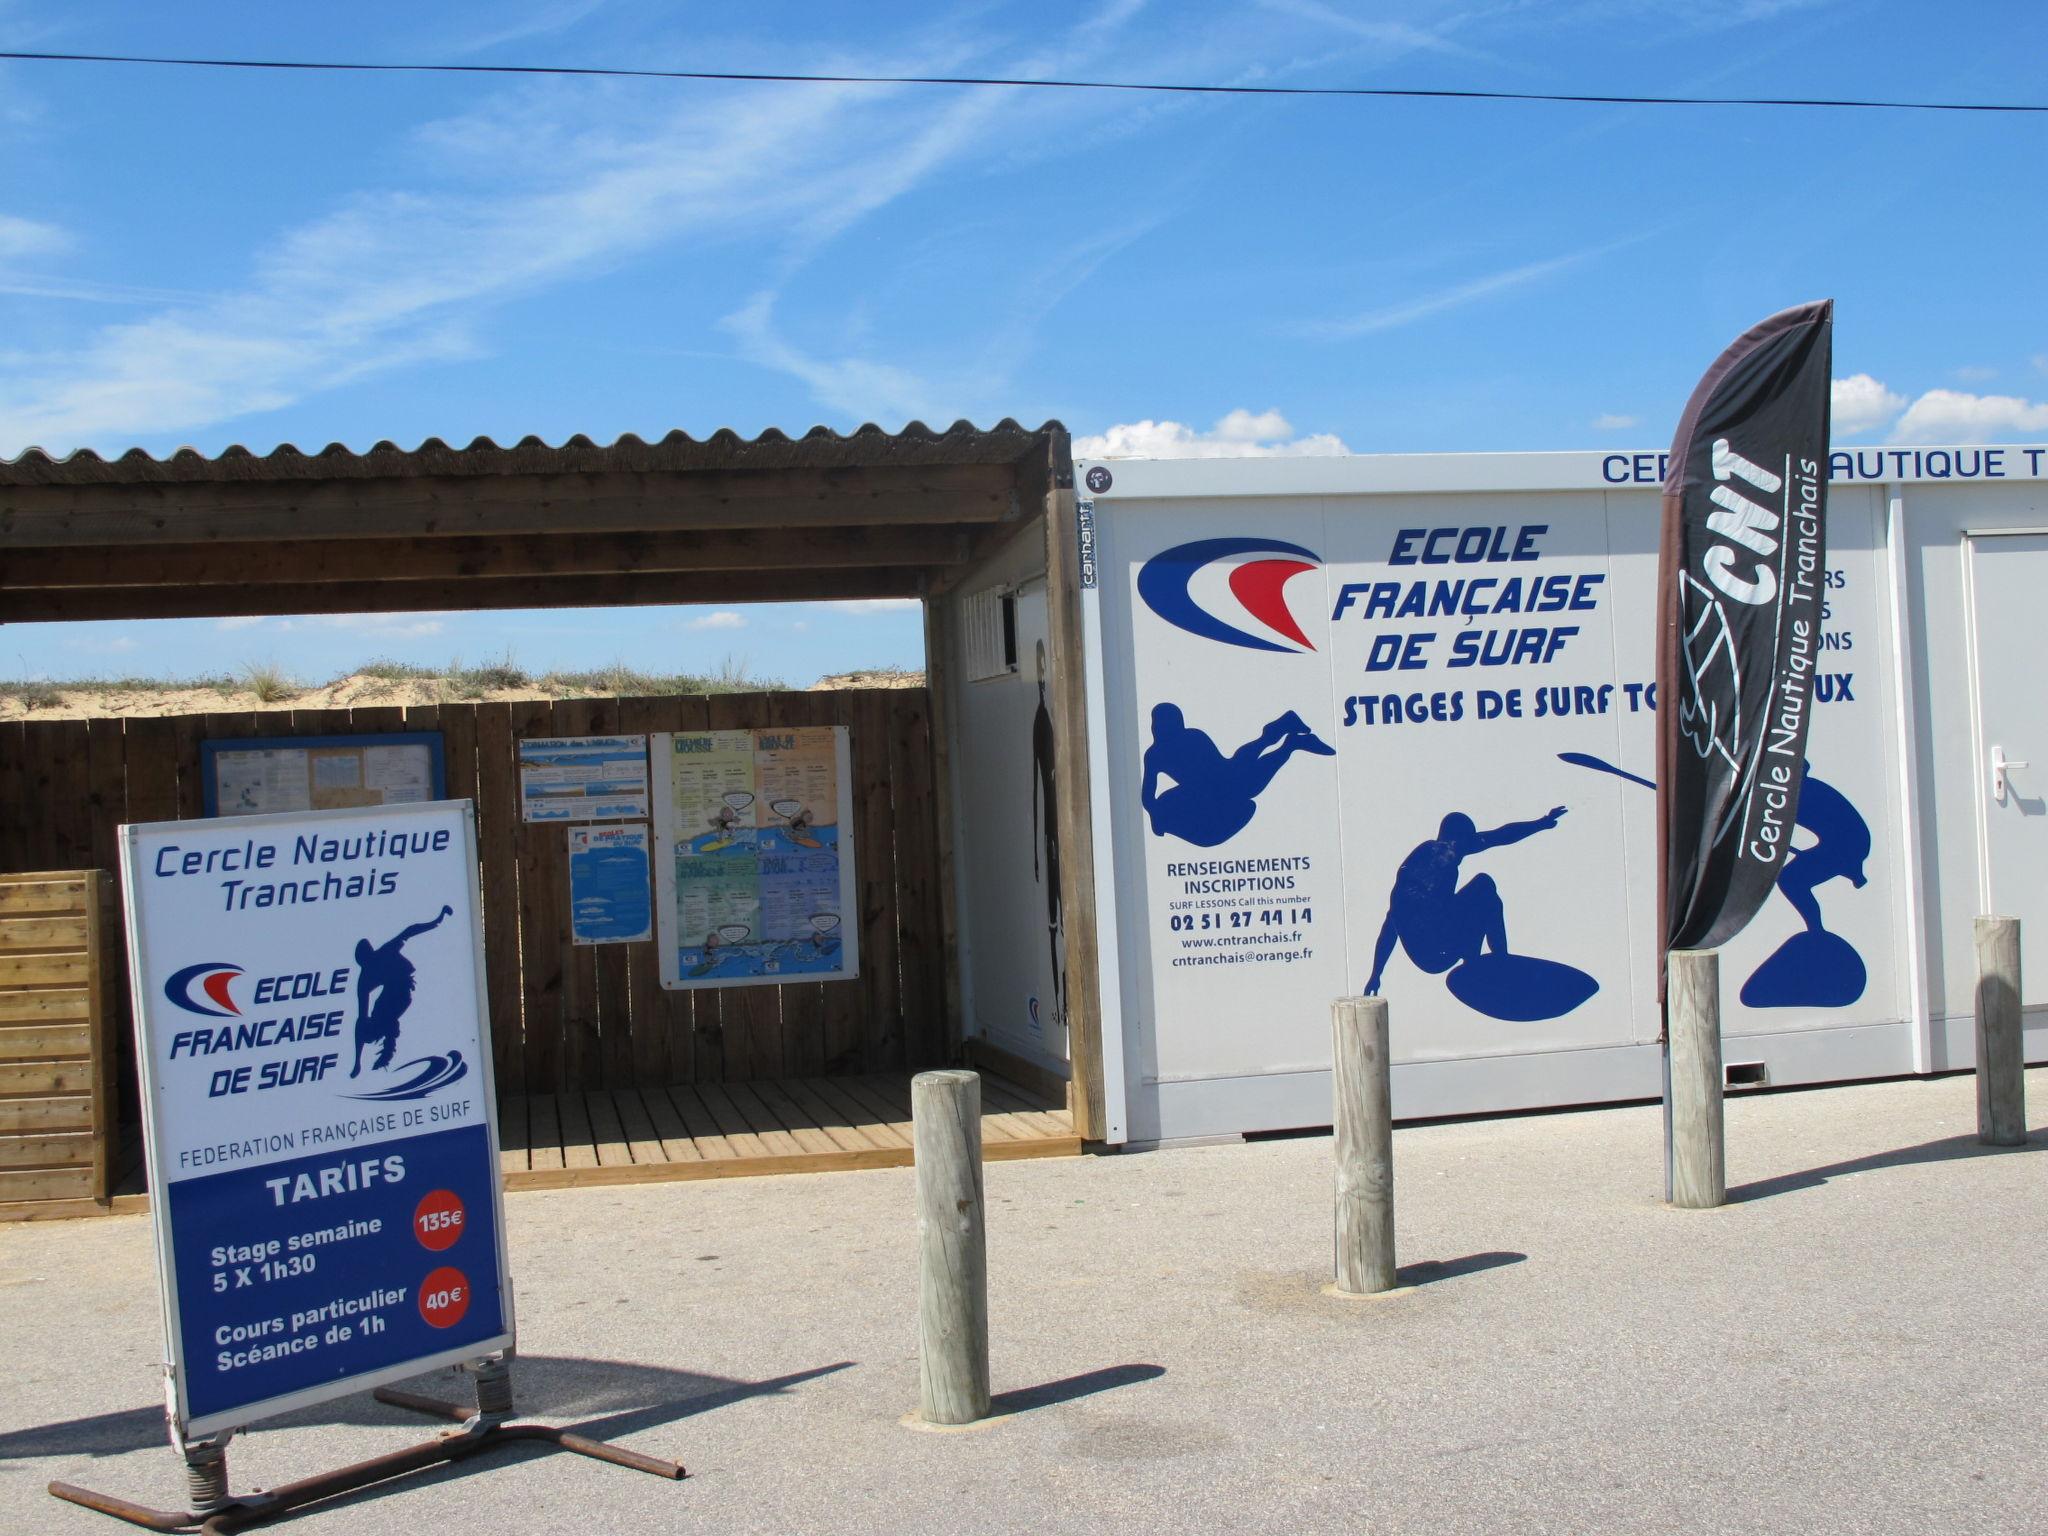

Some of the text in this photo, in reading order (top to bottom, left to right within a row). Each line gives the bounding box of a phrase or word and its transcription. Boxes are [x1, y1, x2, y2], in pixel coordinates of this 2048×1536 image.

[1829, 450, 2005, 480] AUTIQUE
[1703, 437, 1782, 606] CNT
[1080, 506, 1093, 585] carhartt
[1388, 524, 1549, 566] ECOLE
[1331, 574, 1606, 625] FRANÇAISE
[1365, 626, 1580, 673] DE SURF
[1750, 457, 1819, 865] Cercle Nautique Tranchais
[1343, 690, 1466, 727] STAGES
[1476, 687, 1522, 719] DE
[1533, 684, 1615, 716] SURF
[155, 829, 451, 878] Cercle Nautique
[1167, 856, 1311, 877] RENSEIGNEMENTS
[221, 868, 400, 911] Tranchais
[1169, 895, 1311, 910] SURF LESSONS Call this number
[1184, 876, 1295, 894] INSCRIPTIONS
[1181, 931, 1302, 949] www.cntranchais.fr
[1230, 911, 1252, 928] 27
[1172, 948, 1313, 967] cntranchais@orange.fr
[254, 967, 350, 1005] ECOLE
[208, 1053, 339, 1099] DE SURF
[180, 1100, 471, 1169] FEDERATION FRANÇAISE DE SURF
[419, 1209, 463, 1232] 135€
[211, 1218, 383, 1268] Stage semaine
[213, 1253, 316, 1293] 5 X 1h30
[215, 1286, 408, 1346] Cours particulier
[216, 1316, 386, 1372] Scéance de 1h
